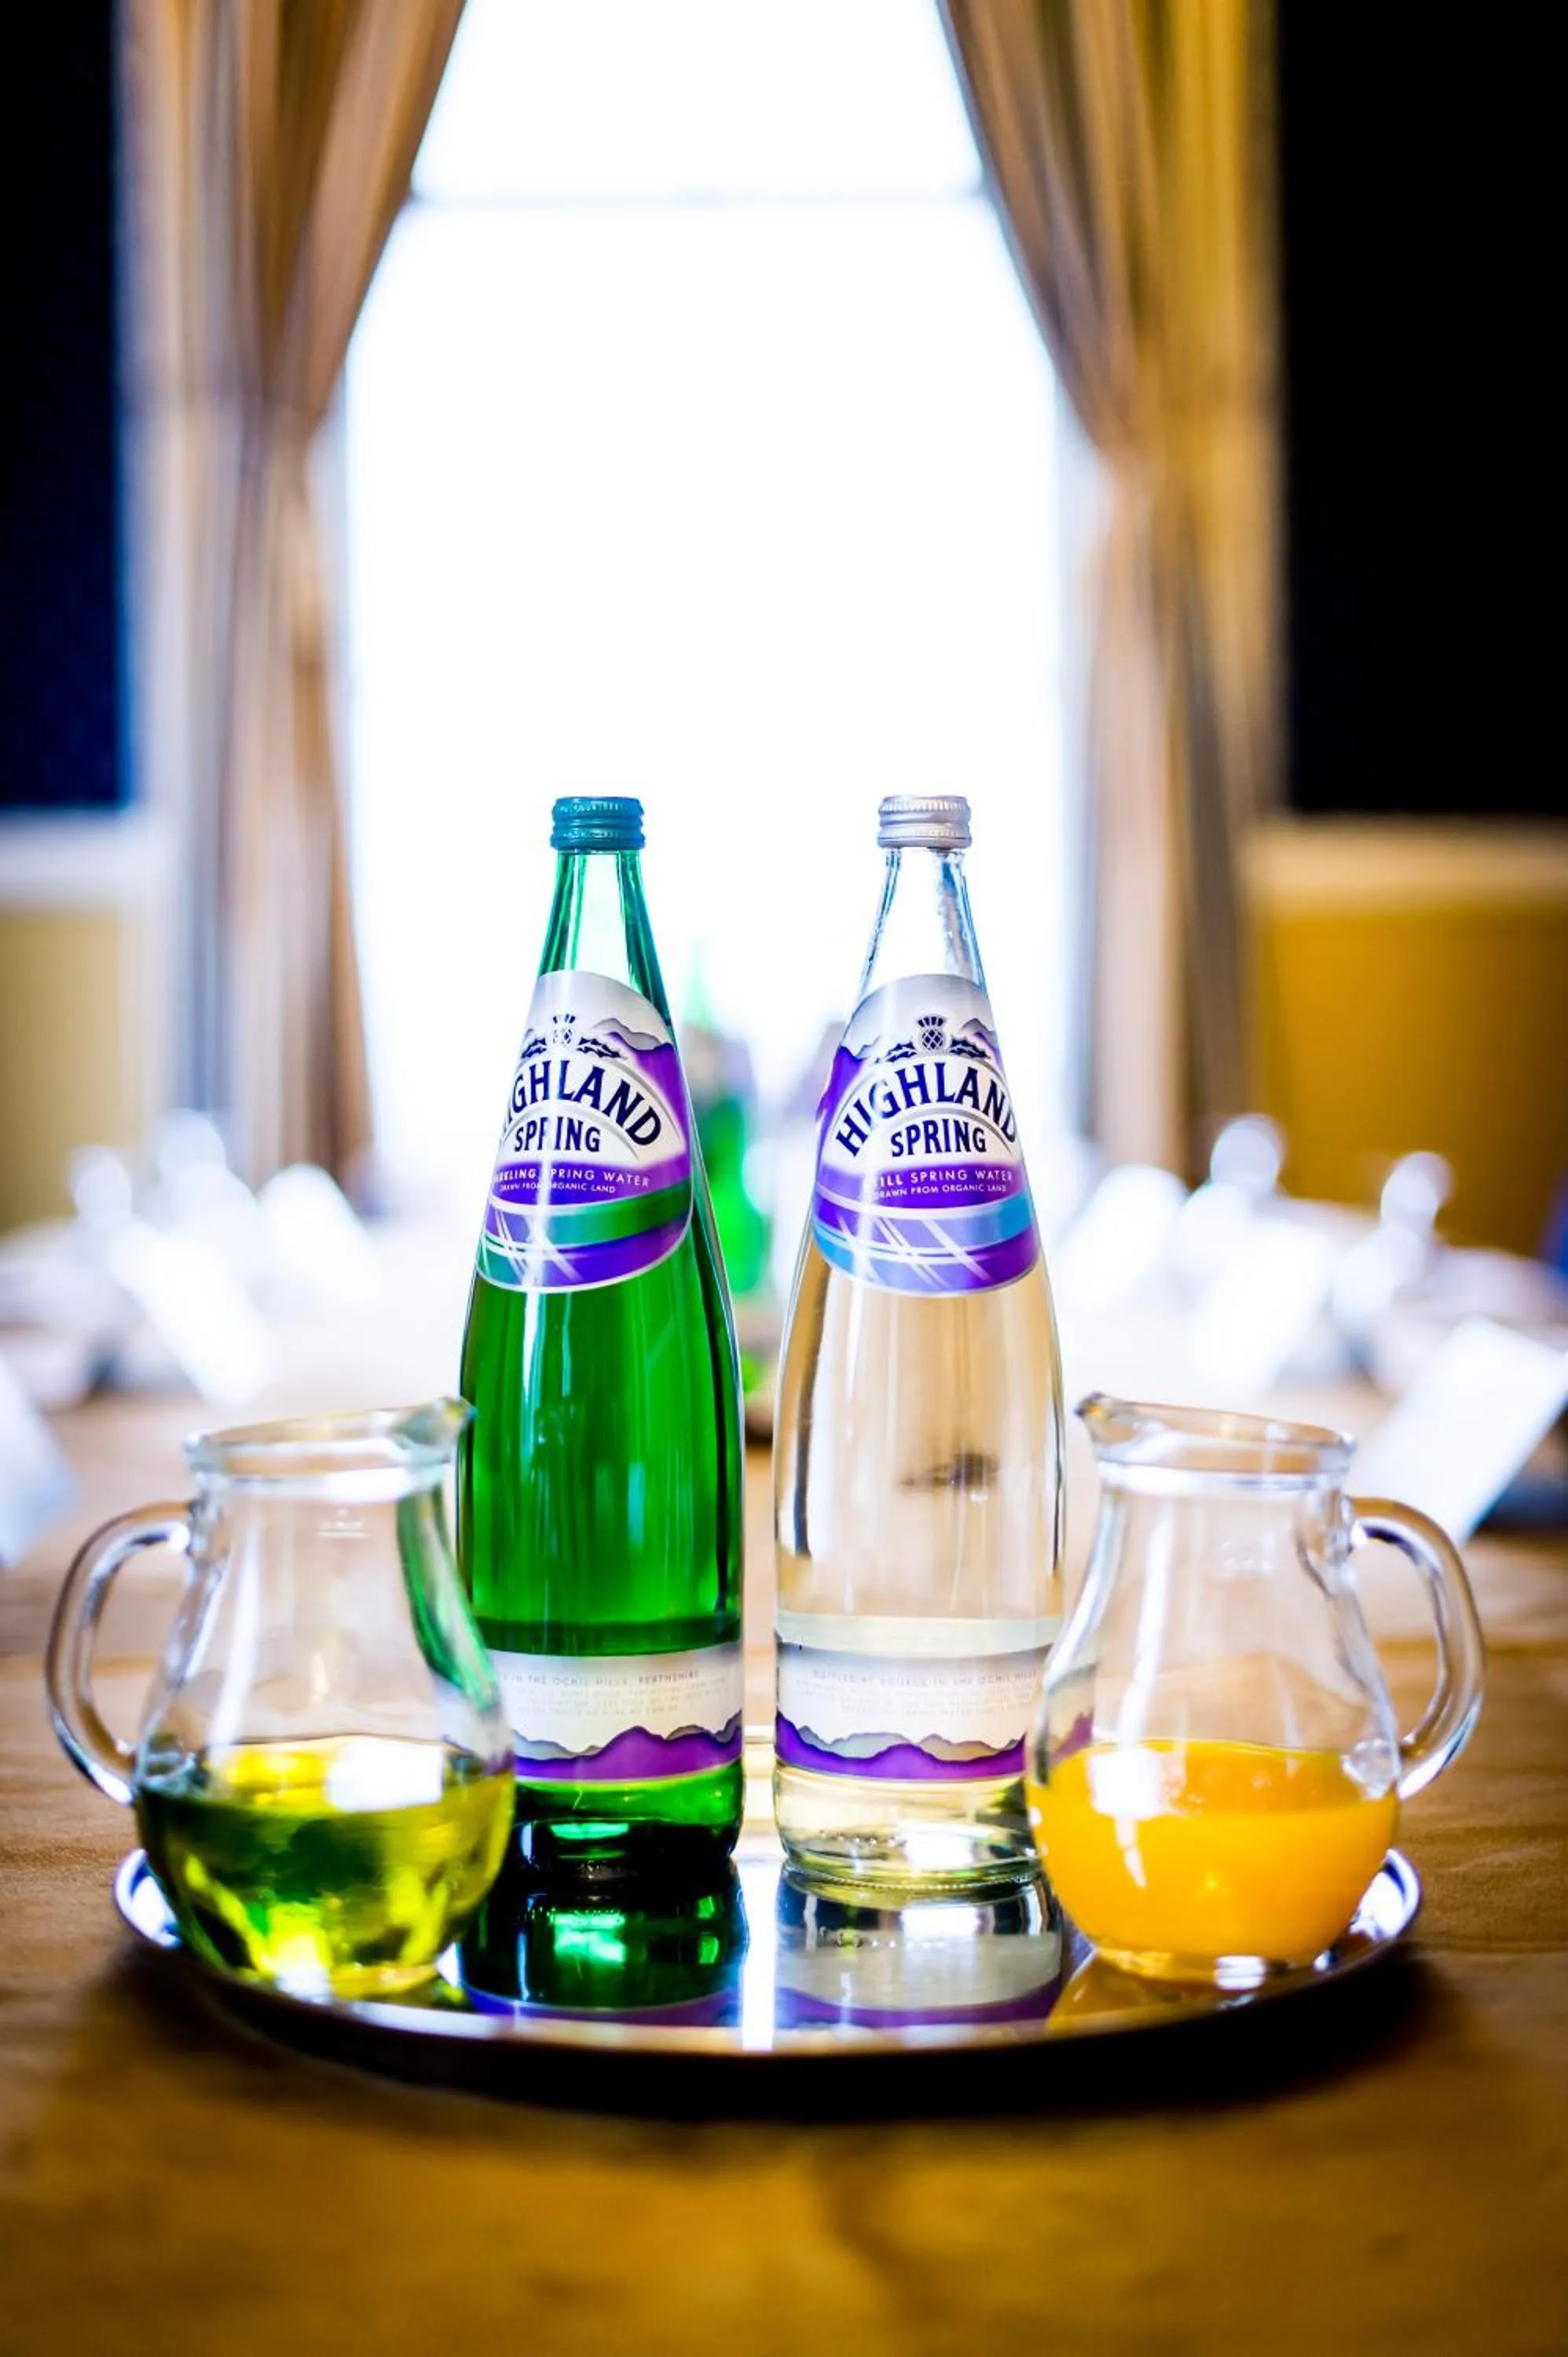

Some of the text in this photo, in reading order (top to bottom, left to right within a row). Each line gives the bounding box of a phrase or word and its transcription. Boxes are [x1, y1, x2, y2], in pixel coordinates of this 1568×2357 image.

[503, 1060, 661, 1146] GHLAND
[835, 1061, 1017, 1157] HIGHLAND
[890, 1119, 987, 1157] SPRING
[550, 1182, 588, 1192] RGANIC
[591, 1184, 616, 1193] LAND
[551, 1168, 595, 1181] PRING
[603, 1171, 650, 1188] WATER
[875, 1168, 1013, 1188] ILL SPRING WATER
[910, 1185, 940, 1195] FROM
[942, 1183, 984, 1193] ORGANIC
